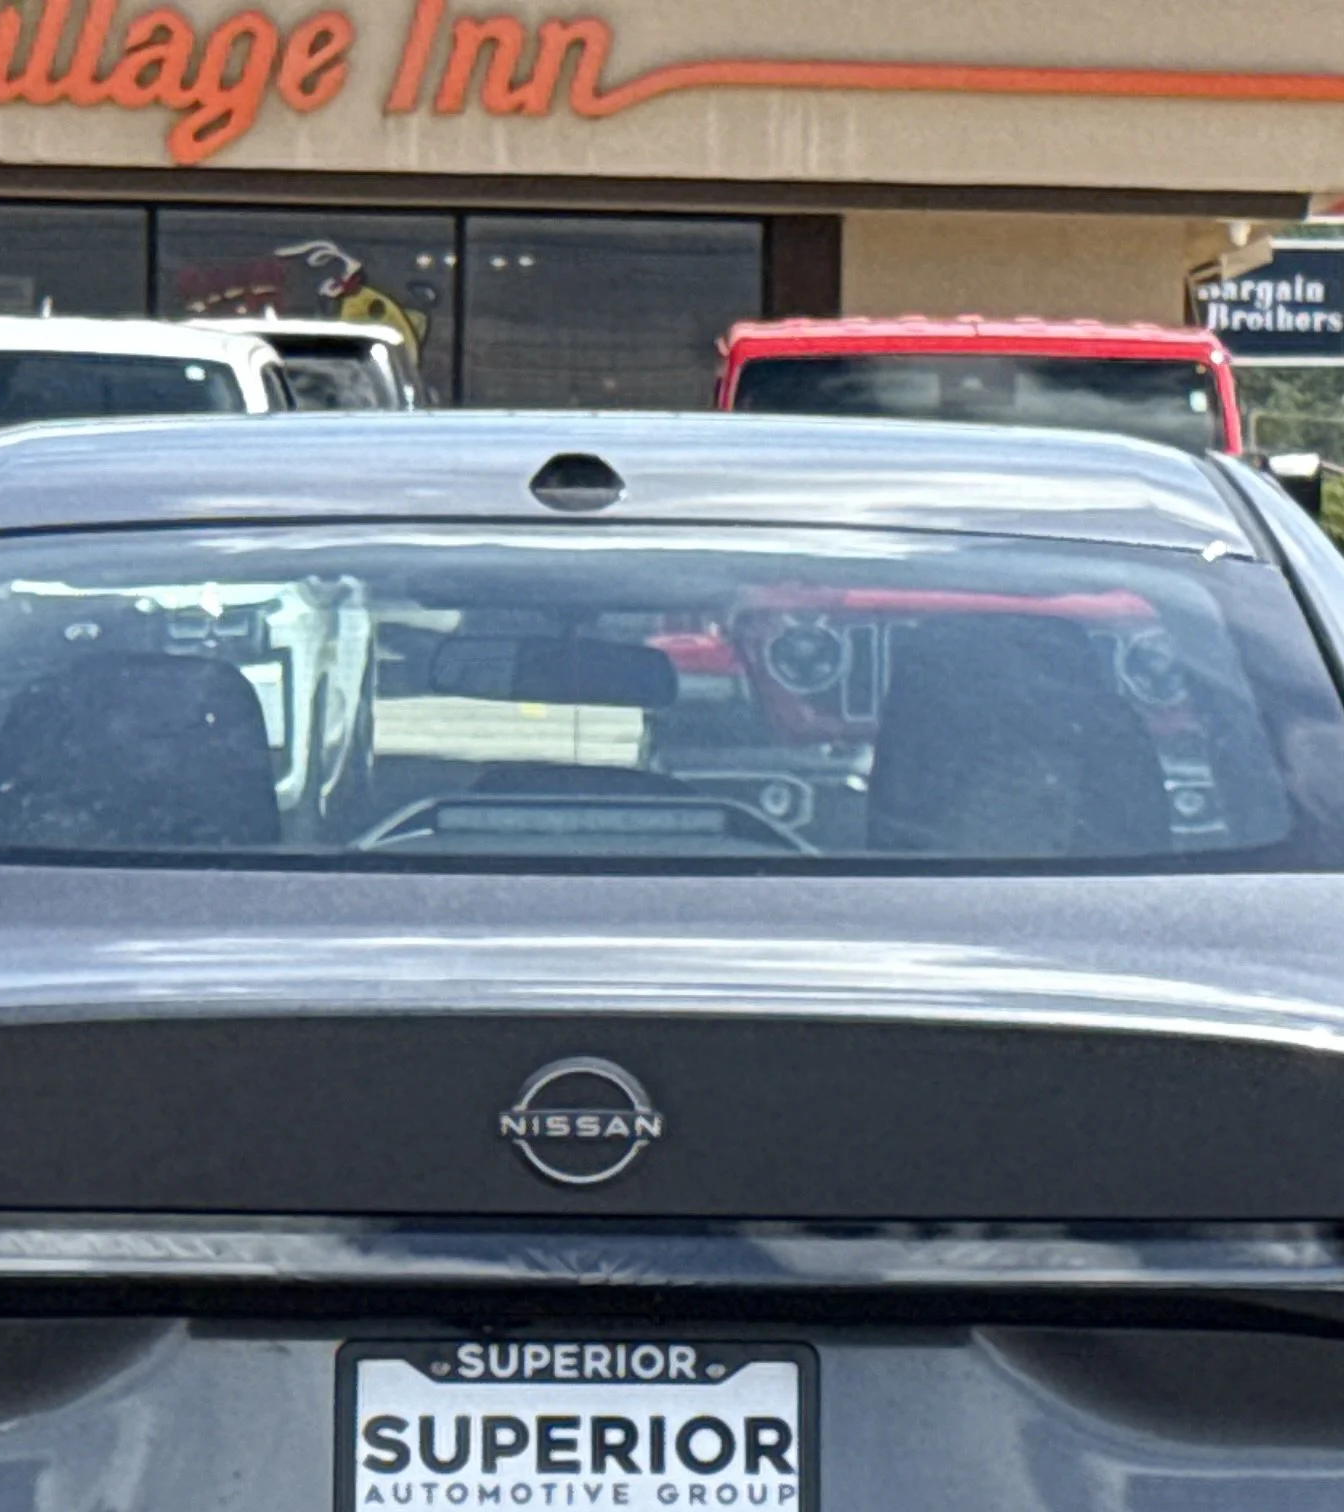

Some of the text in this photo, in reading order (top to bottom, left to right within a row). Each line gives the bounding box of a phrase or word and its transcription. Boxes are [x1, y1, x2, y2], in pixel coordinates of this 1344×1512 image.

[384, 0, 622, 118] Inn
[1207, 302, 1344, 332] Brothers
[500, 1114, 662, 1138] NISSAN
[457, 1343, 698, 1380] SUPERIOR
[362, 1415, 797, 1475] SUPERIOR
[364, 1483, 798, 1505] AUTOMOTIVE GROUP
